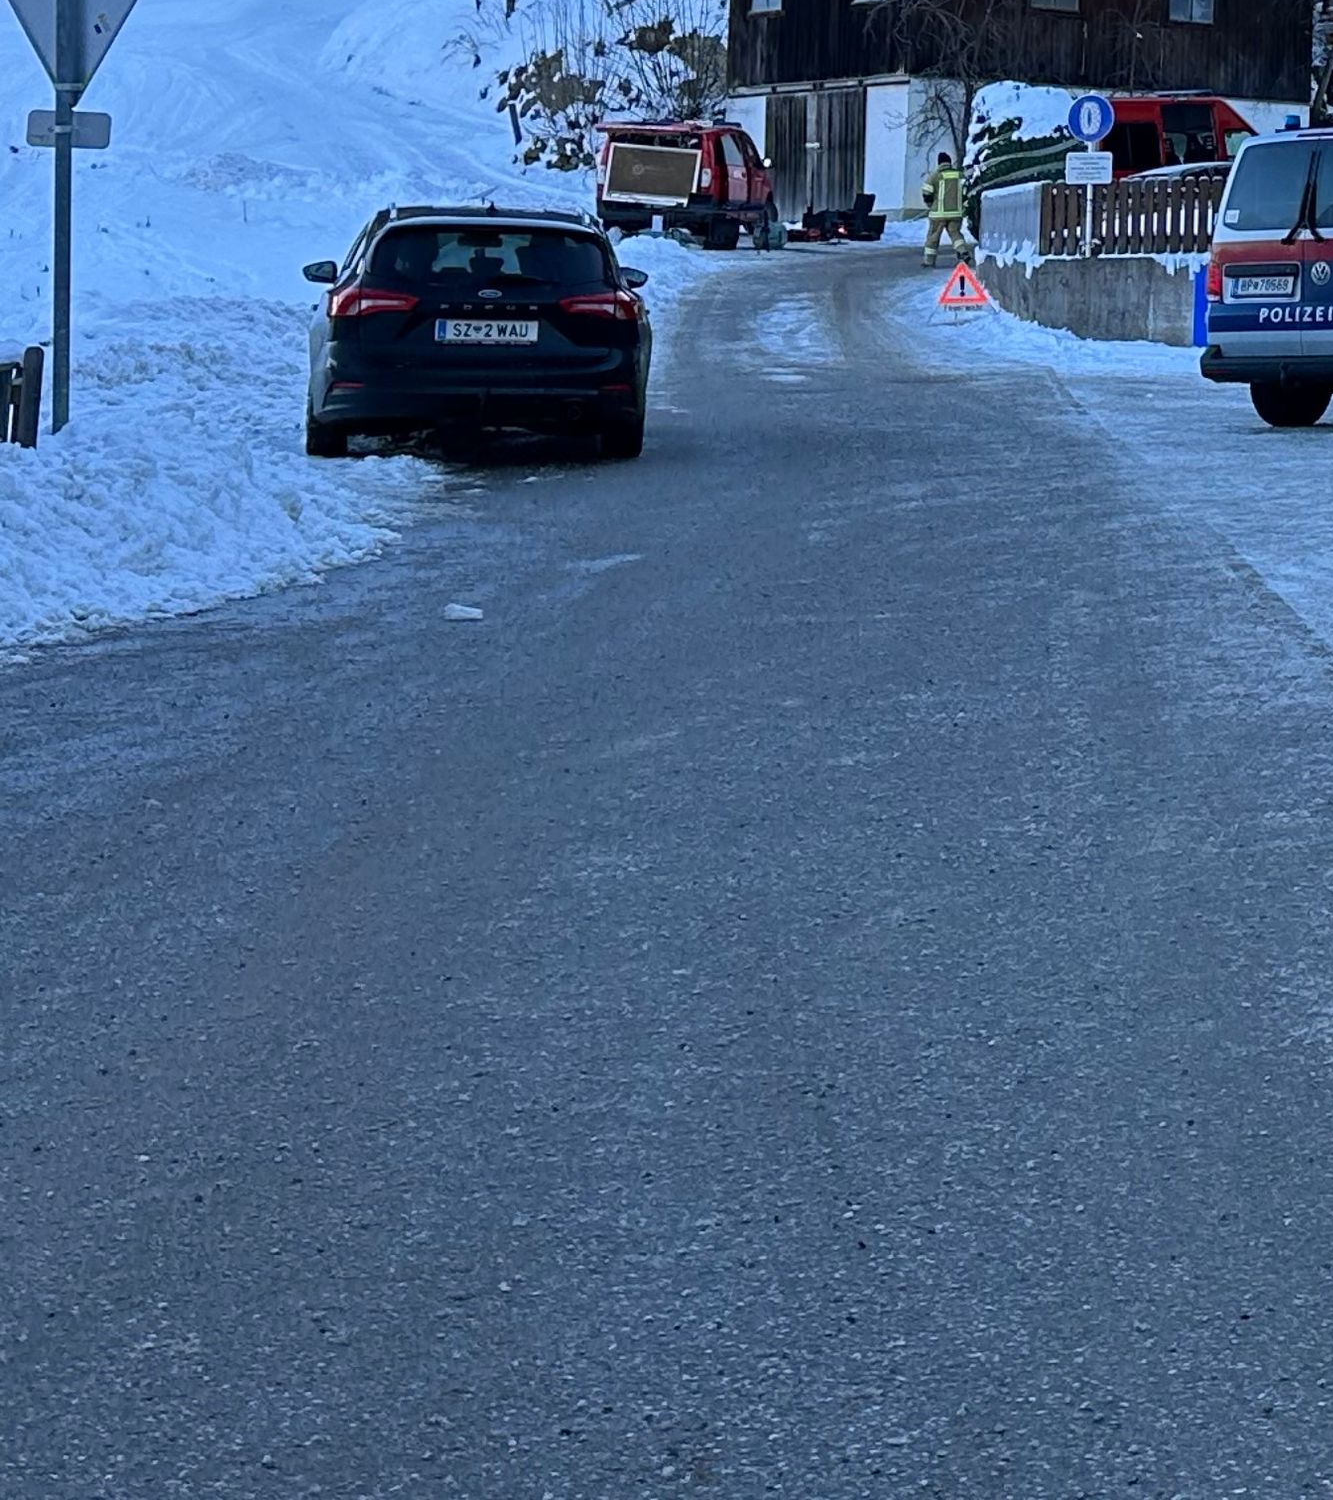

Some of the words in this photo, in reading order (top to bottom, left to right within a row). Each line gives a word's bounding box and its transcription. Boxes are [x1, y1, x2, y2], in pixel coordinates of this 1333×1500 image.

[1259, 306, 1333, 323] POLIZEI
[453, 323, 472, 337] SZ
[484, 323, 493, 337] 2
[497, 323, 529, 337] WAU
